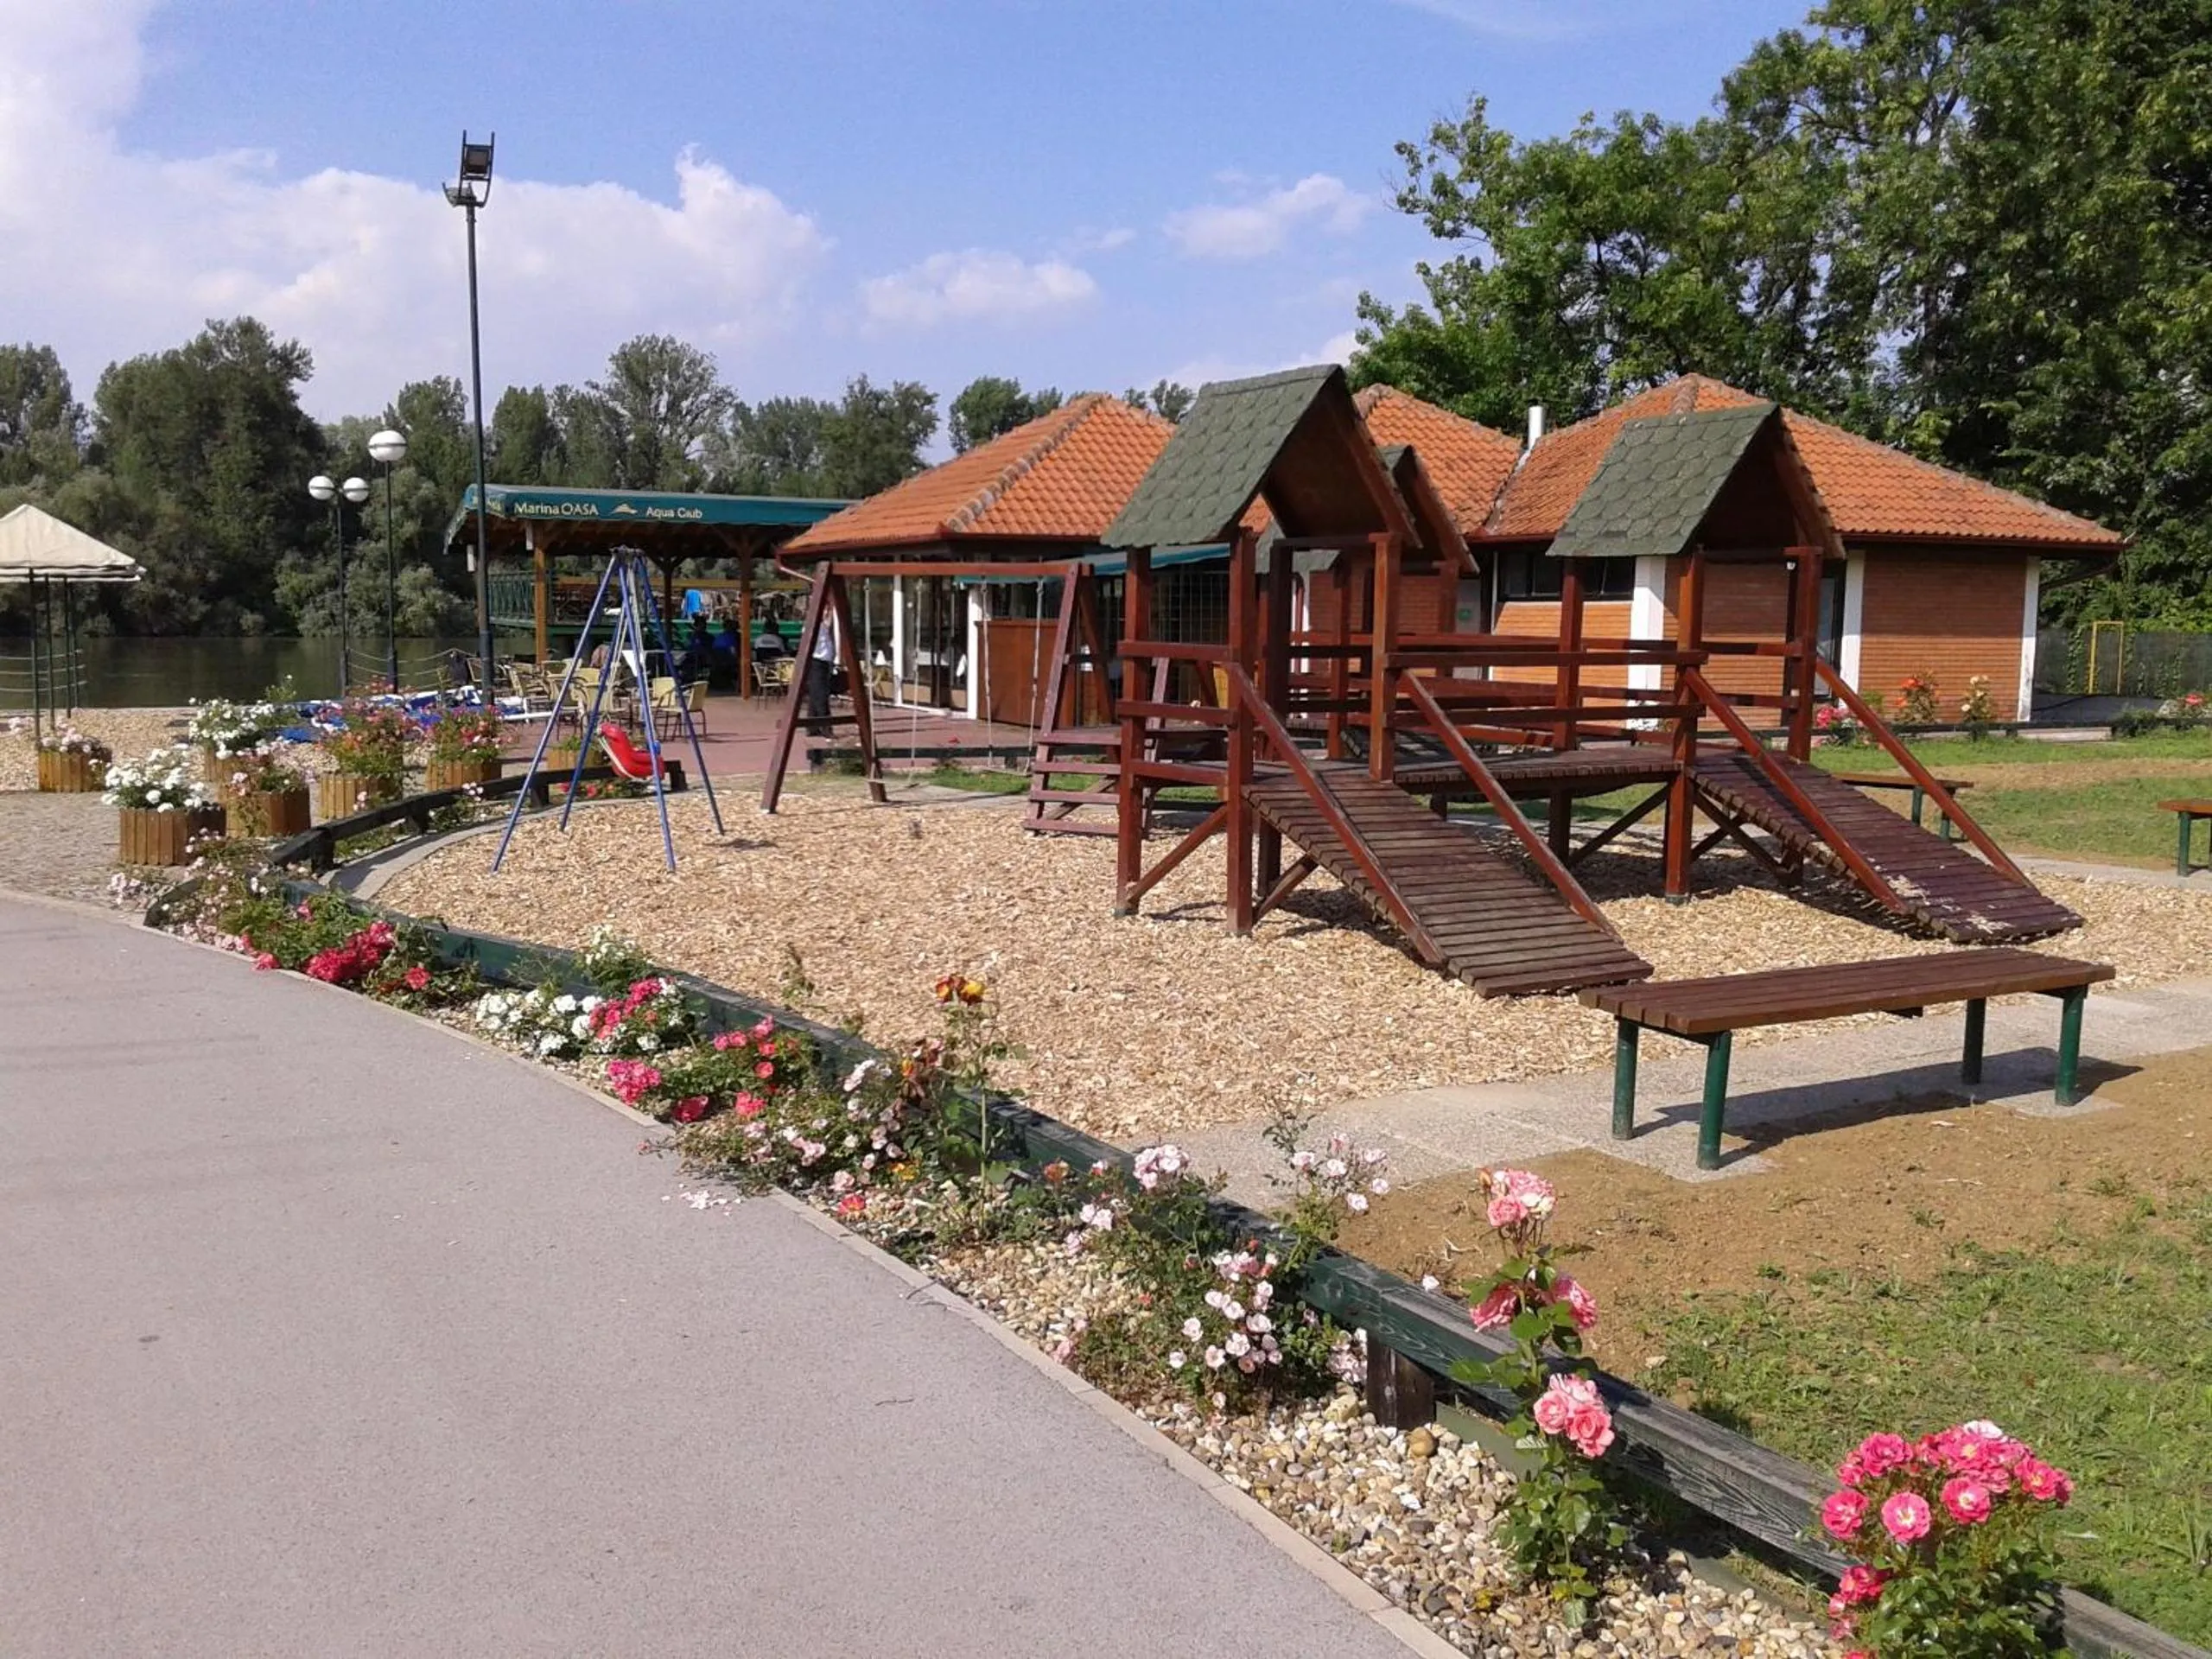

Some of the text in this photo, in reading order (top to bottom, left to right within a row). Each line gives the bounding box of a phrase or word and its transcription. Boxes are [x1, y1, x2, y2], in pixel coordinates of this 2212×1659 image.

[513, 502, 560, 515] Marina
[561, 502, 599, 516] OASA
[645, 506, 702, 519] Aqua Club
